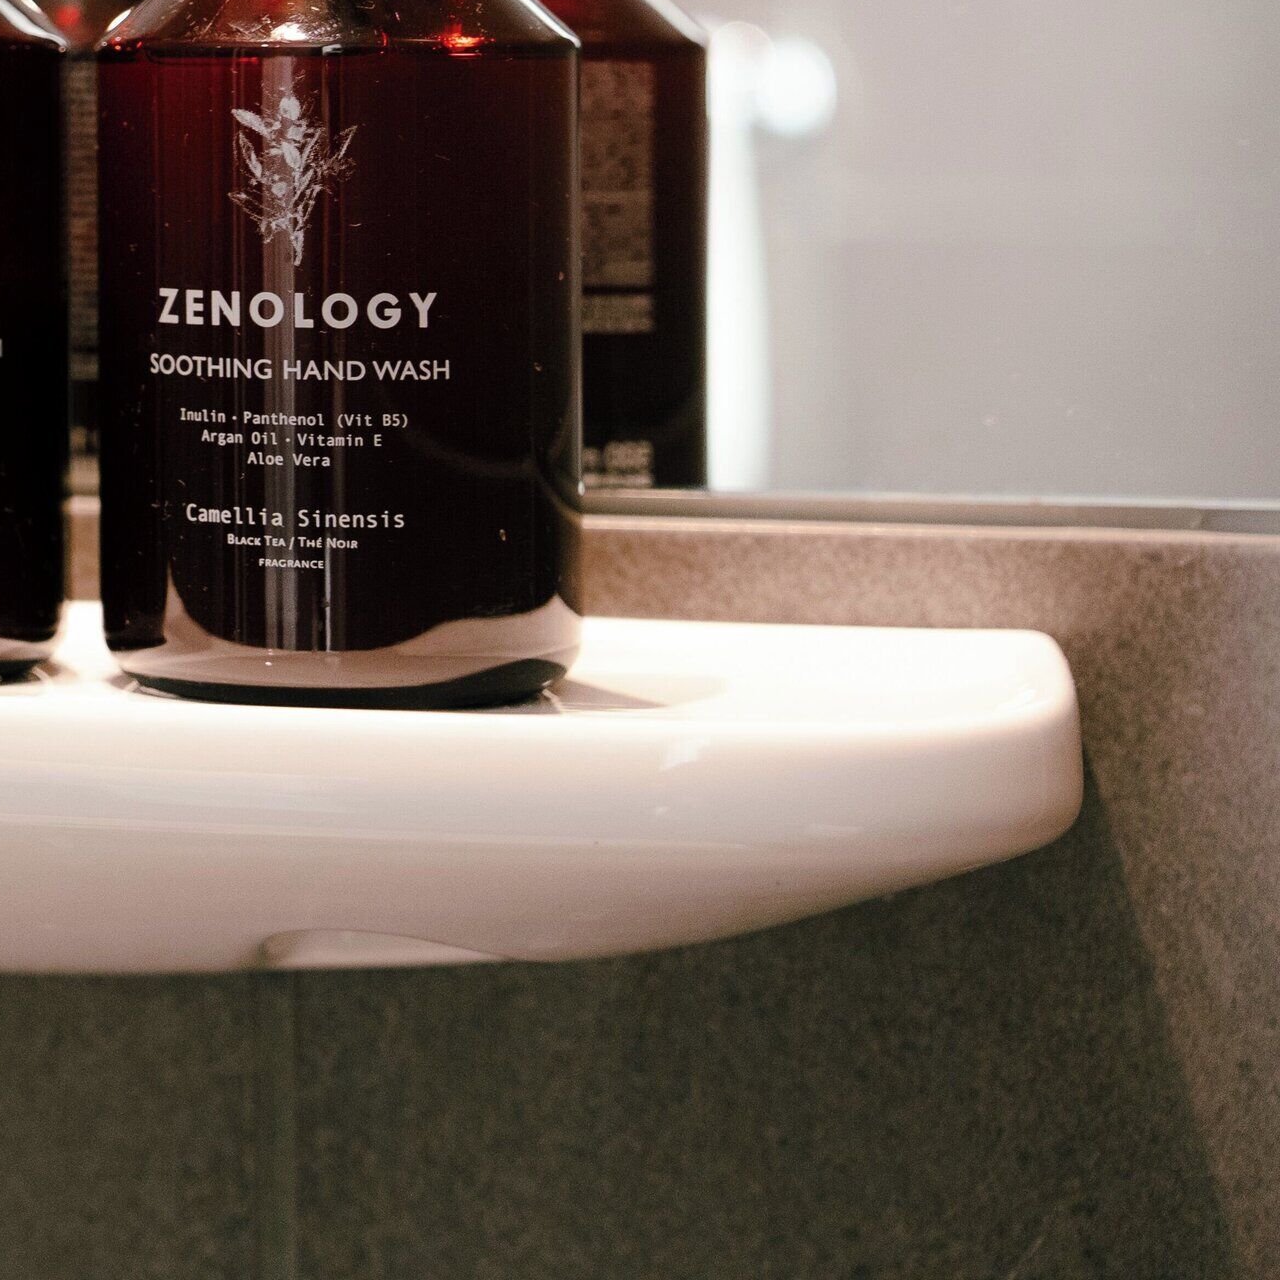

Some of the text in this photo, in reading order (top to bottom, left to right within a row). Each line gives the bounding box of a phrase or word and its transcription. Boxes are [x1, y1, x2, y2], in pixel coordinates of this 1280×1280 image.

[158, 287, 438, 329] ZENOLOGY
[150, 353, 450, 381] SOOTHING HAND WASH
[180, 408, 409, 428] Inulin Panthenol (Vit B5)
[201, 429, 383, 447] Argan Oil Vitamin E
[247, 452, 331, 467] Aloe Vera
[186, 503, 405, 528] Camellia Sinensis
[258, 558, 325, 569] FRAGRANCE
